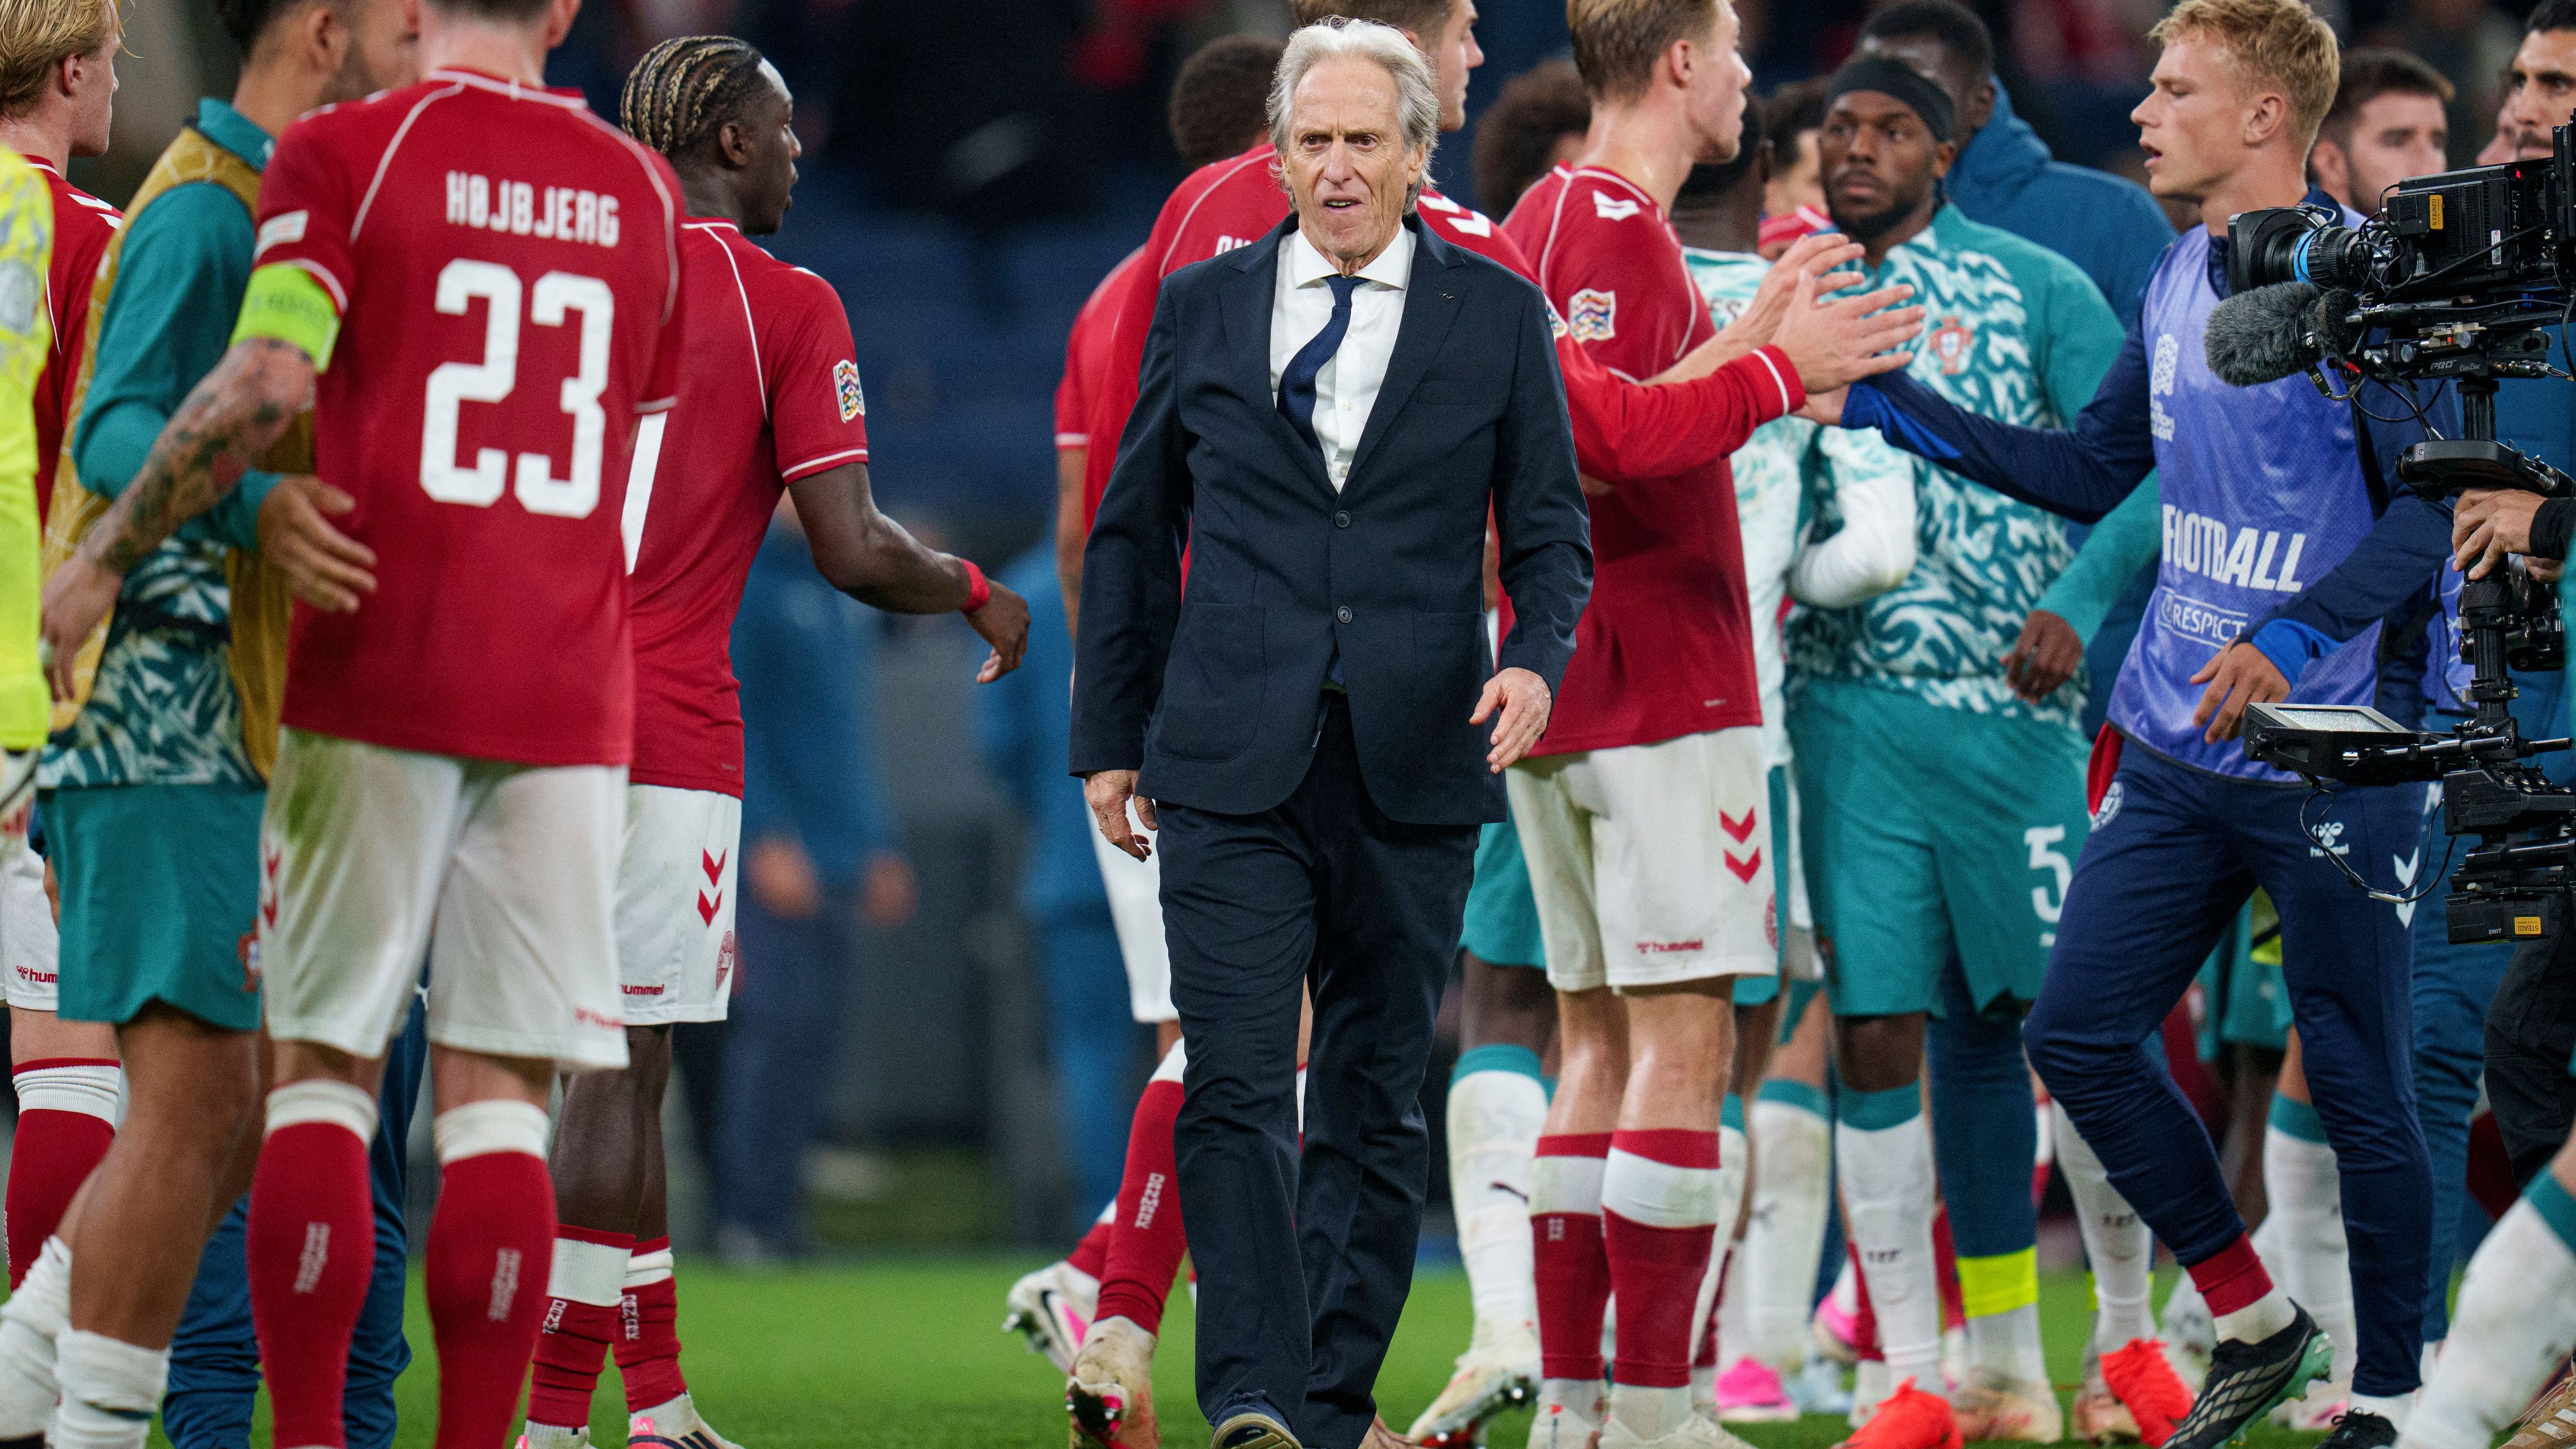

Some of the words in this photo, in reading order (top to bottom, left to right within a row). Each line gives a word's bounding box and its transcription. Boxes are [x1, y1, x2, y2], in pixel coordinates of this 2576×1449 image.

[446, 170, 620, 247] HØJBJERG
[420, 257, 614, 519] 23
[2430, 360, 2454, 370] PRO
[2024, 825, 2073, 923] 5
